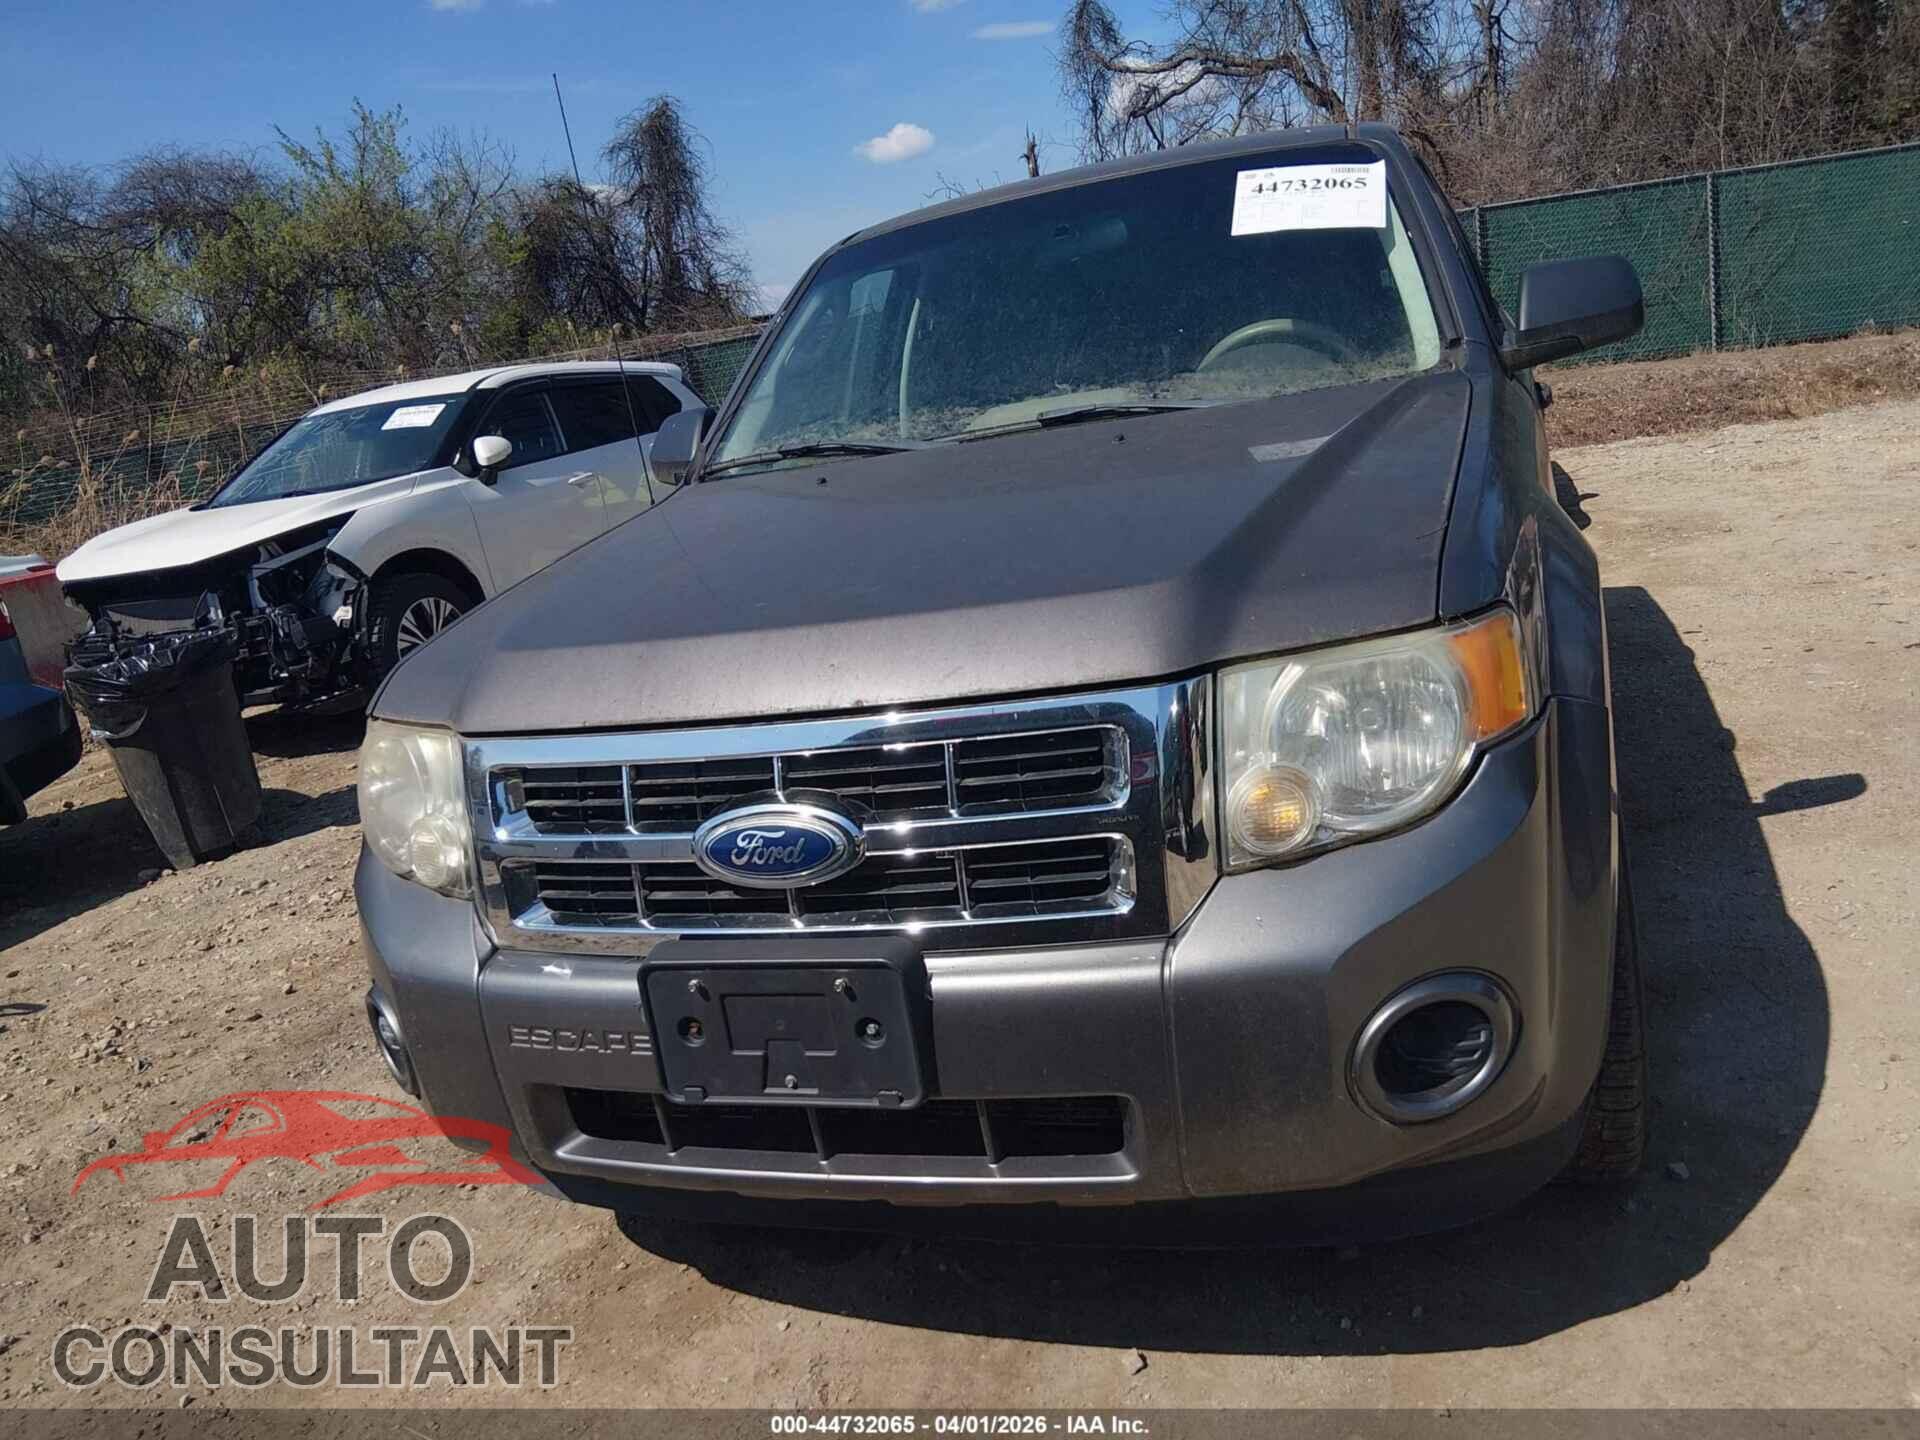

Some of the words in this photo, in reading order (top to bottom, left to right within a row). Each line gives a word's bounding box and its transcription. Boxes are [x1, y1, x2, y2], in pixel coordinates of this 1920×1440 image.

[1251, 177, 1367, 194] 44732065
[730, 829, 806, 866] Ford
[507, 1024, 654, 1056] ESCAPE
